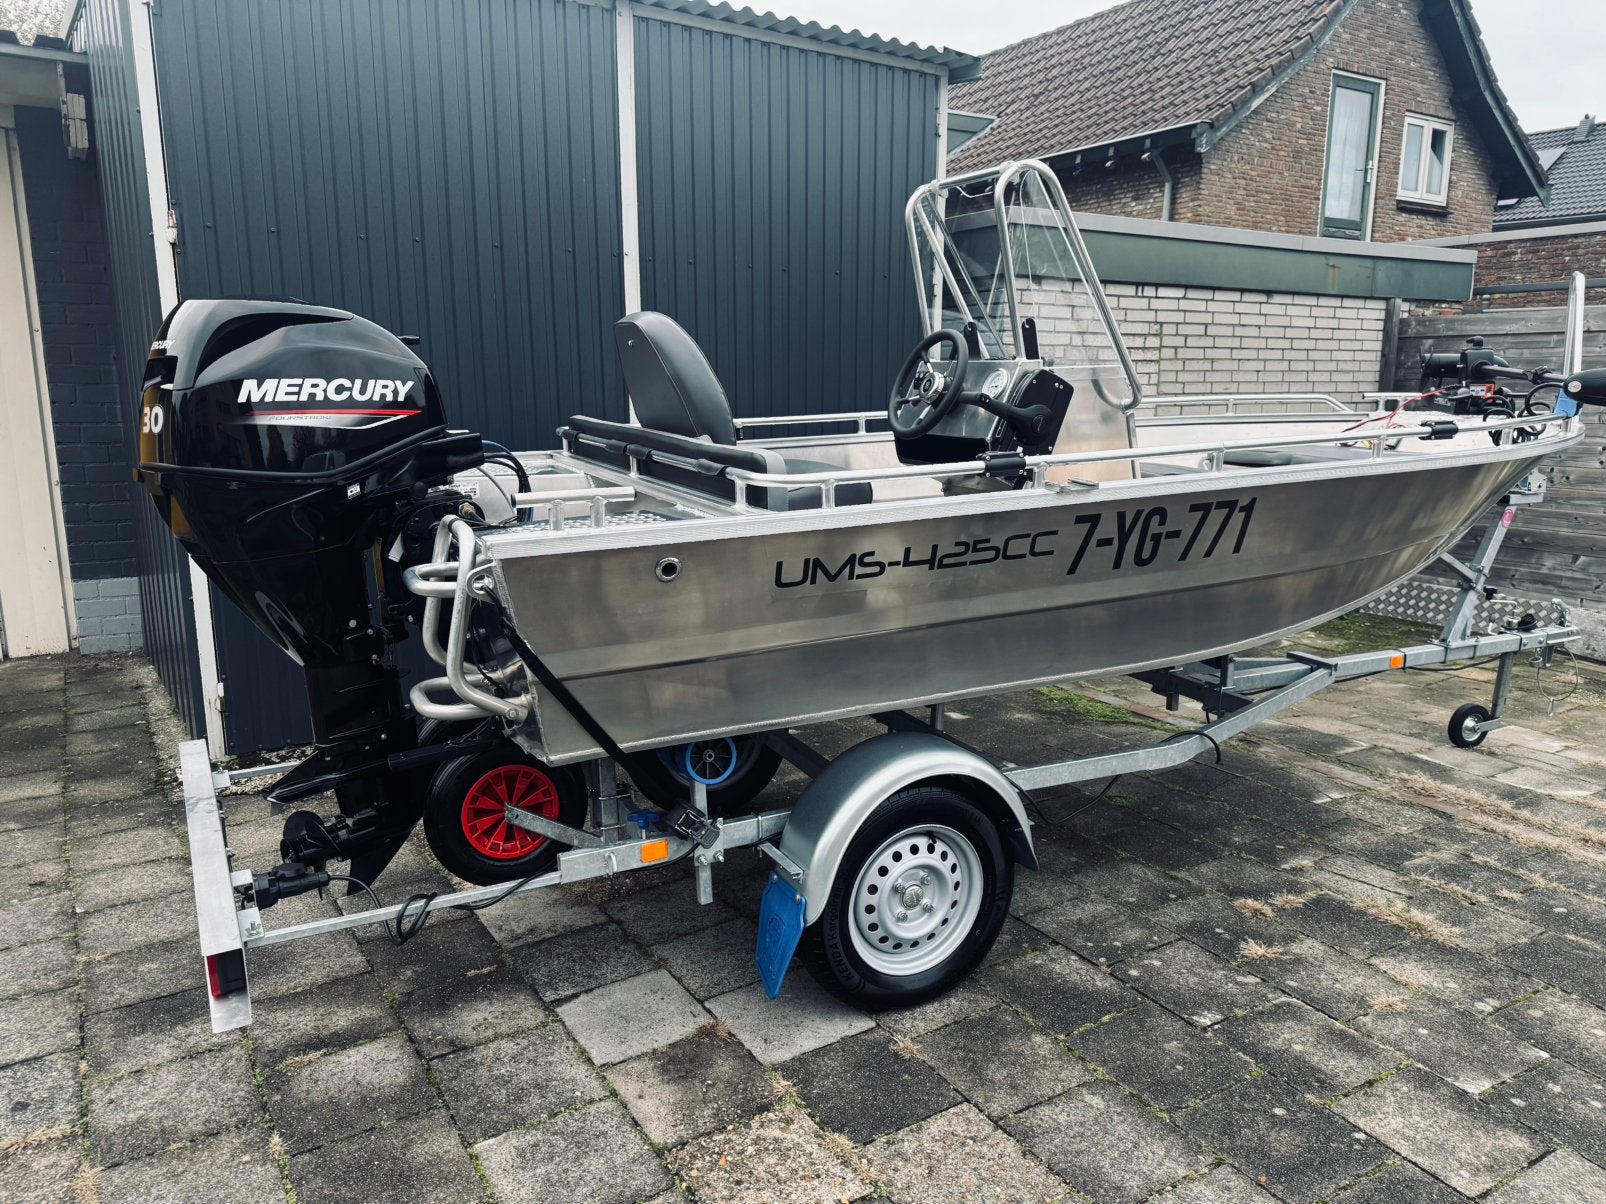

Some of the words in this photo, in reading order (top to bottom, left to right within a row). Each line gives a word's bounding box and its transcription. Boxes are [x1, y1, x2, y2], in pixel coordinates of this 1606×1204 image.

[151, 339, 176, 350] ERCURY
[237, 378, 415, 403] MERCURY
[142, 405, 164, 434] 30
[1066, 497, 1257, 576] 7-YG-771
[774, 529, 1060, 589] UMS-425CC
[829, 942, 855, 982] KENDA
